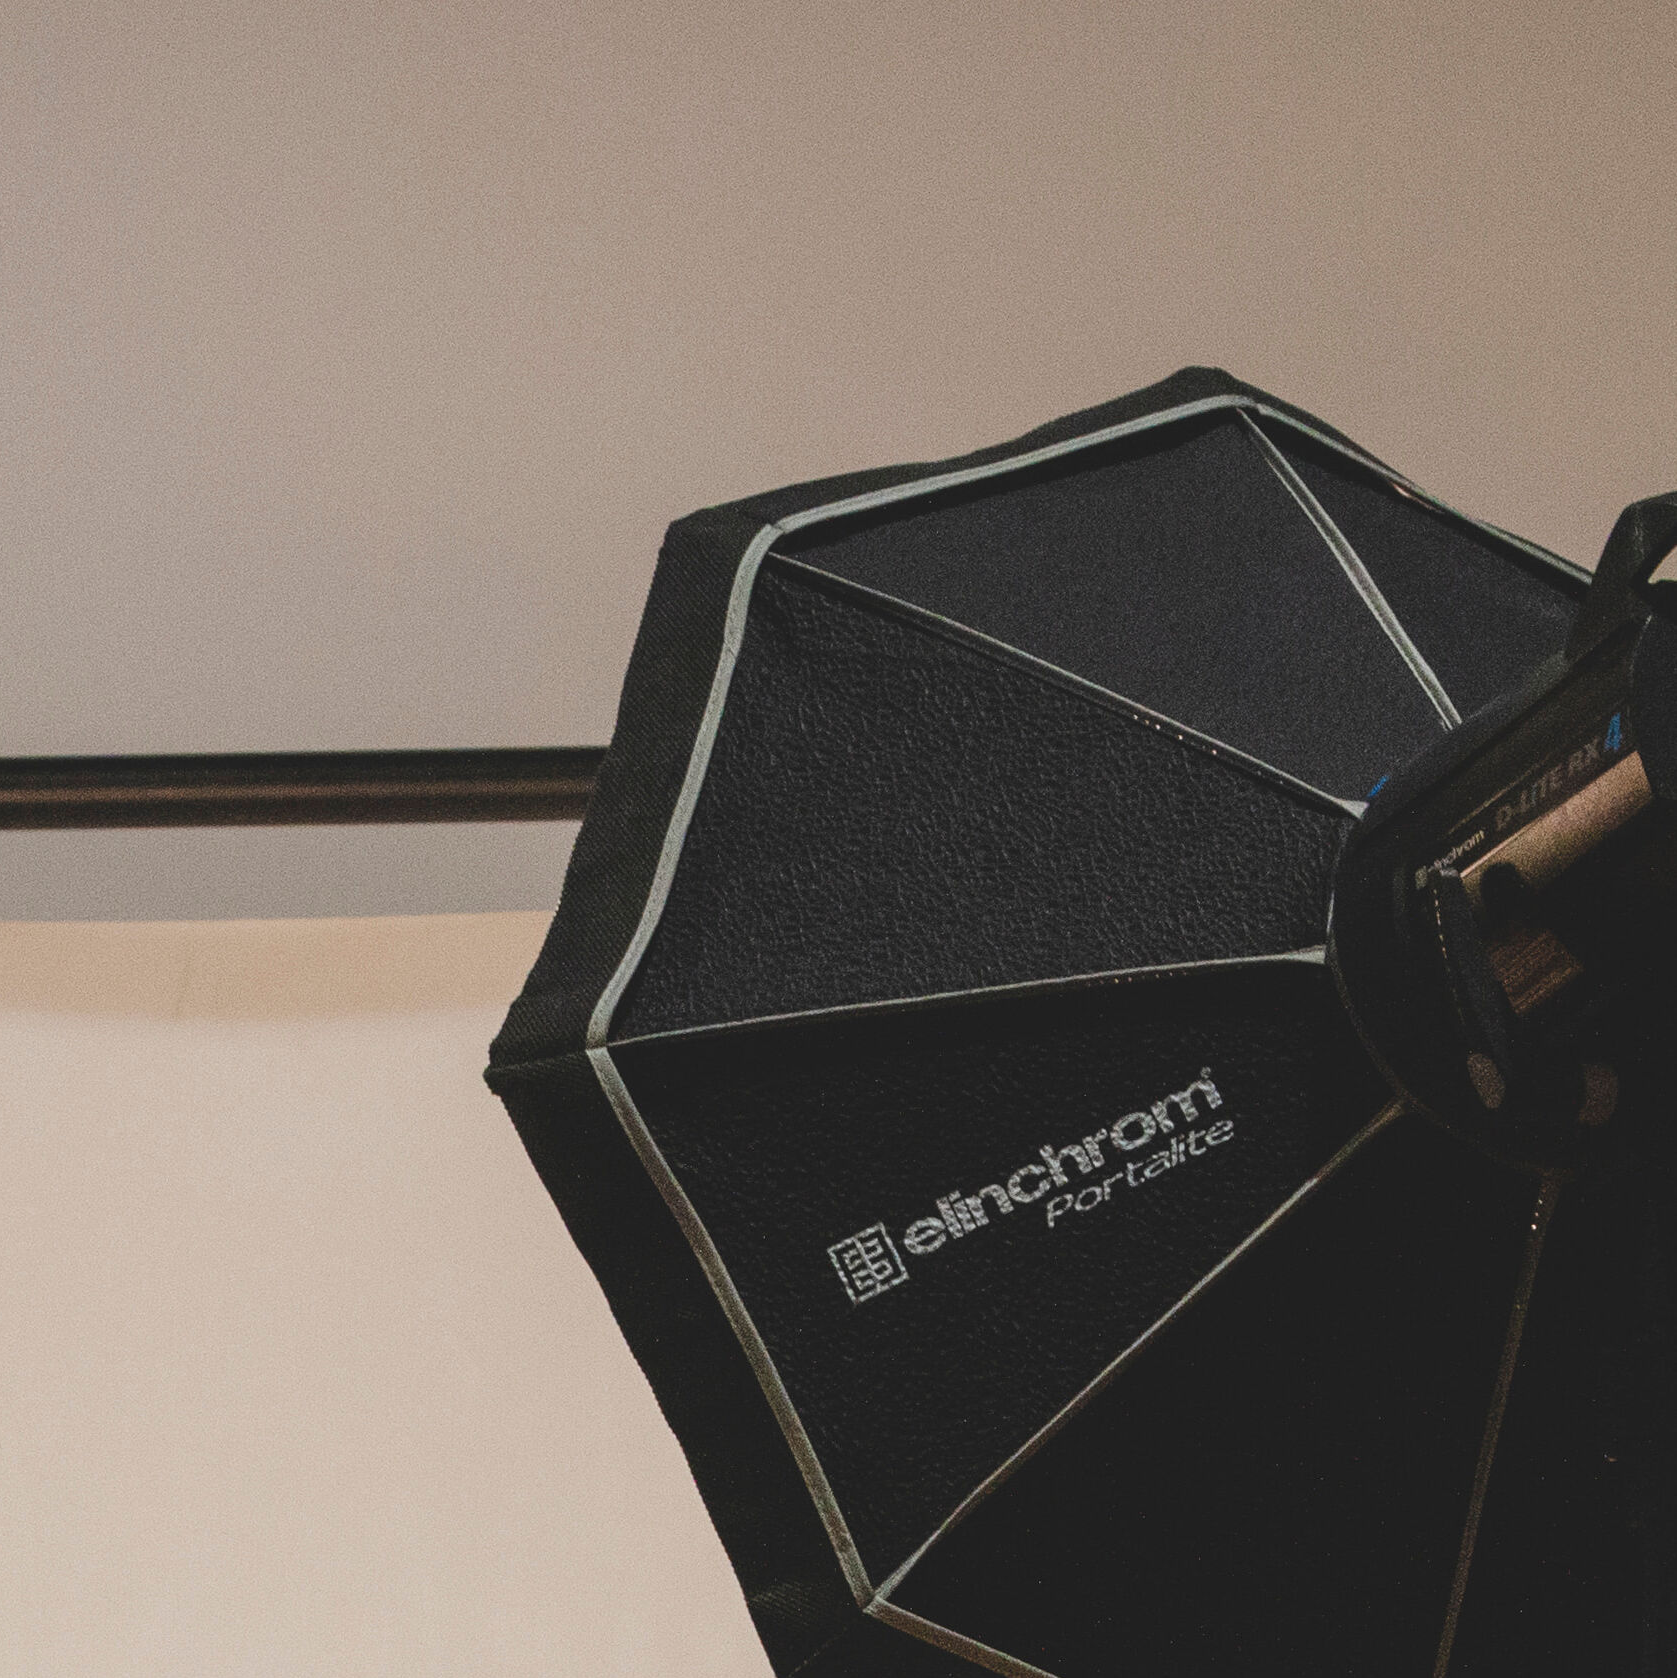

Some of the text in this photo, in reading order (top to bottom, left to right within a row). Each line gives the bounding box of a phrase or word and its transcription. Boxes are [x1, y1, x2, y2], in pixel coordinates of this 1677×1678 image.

[1603, 712, 1623, 752] 4
[902, 1076, 1223, 1257] elinchrom
[1045, 1119, 1236, 1229] Portalite
